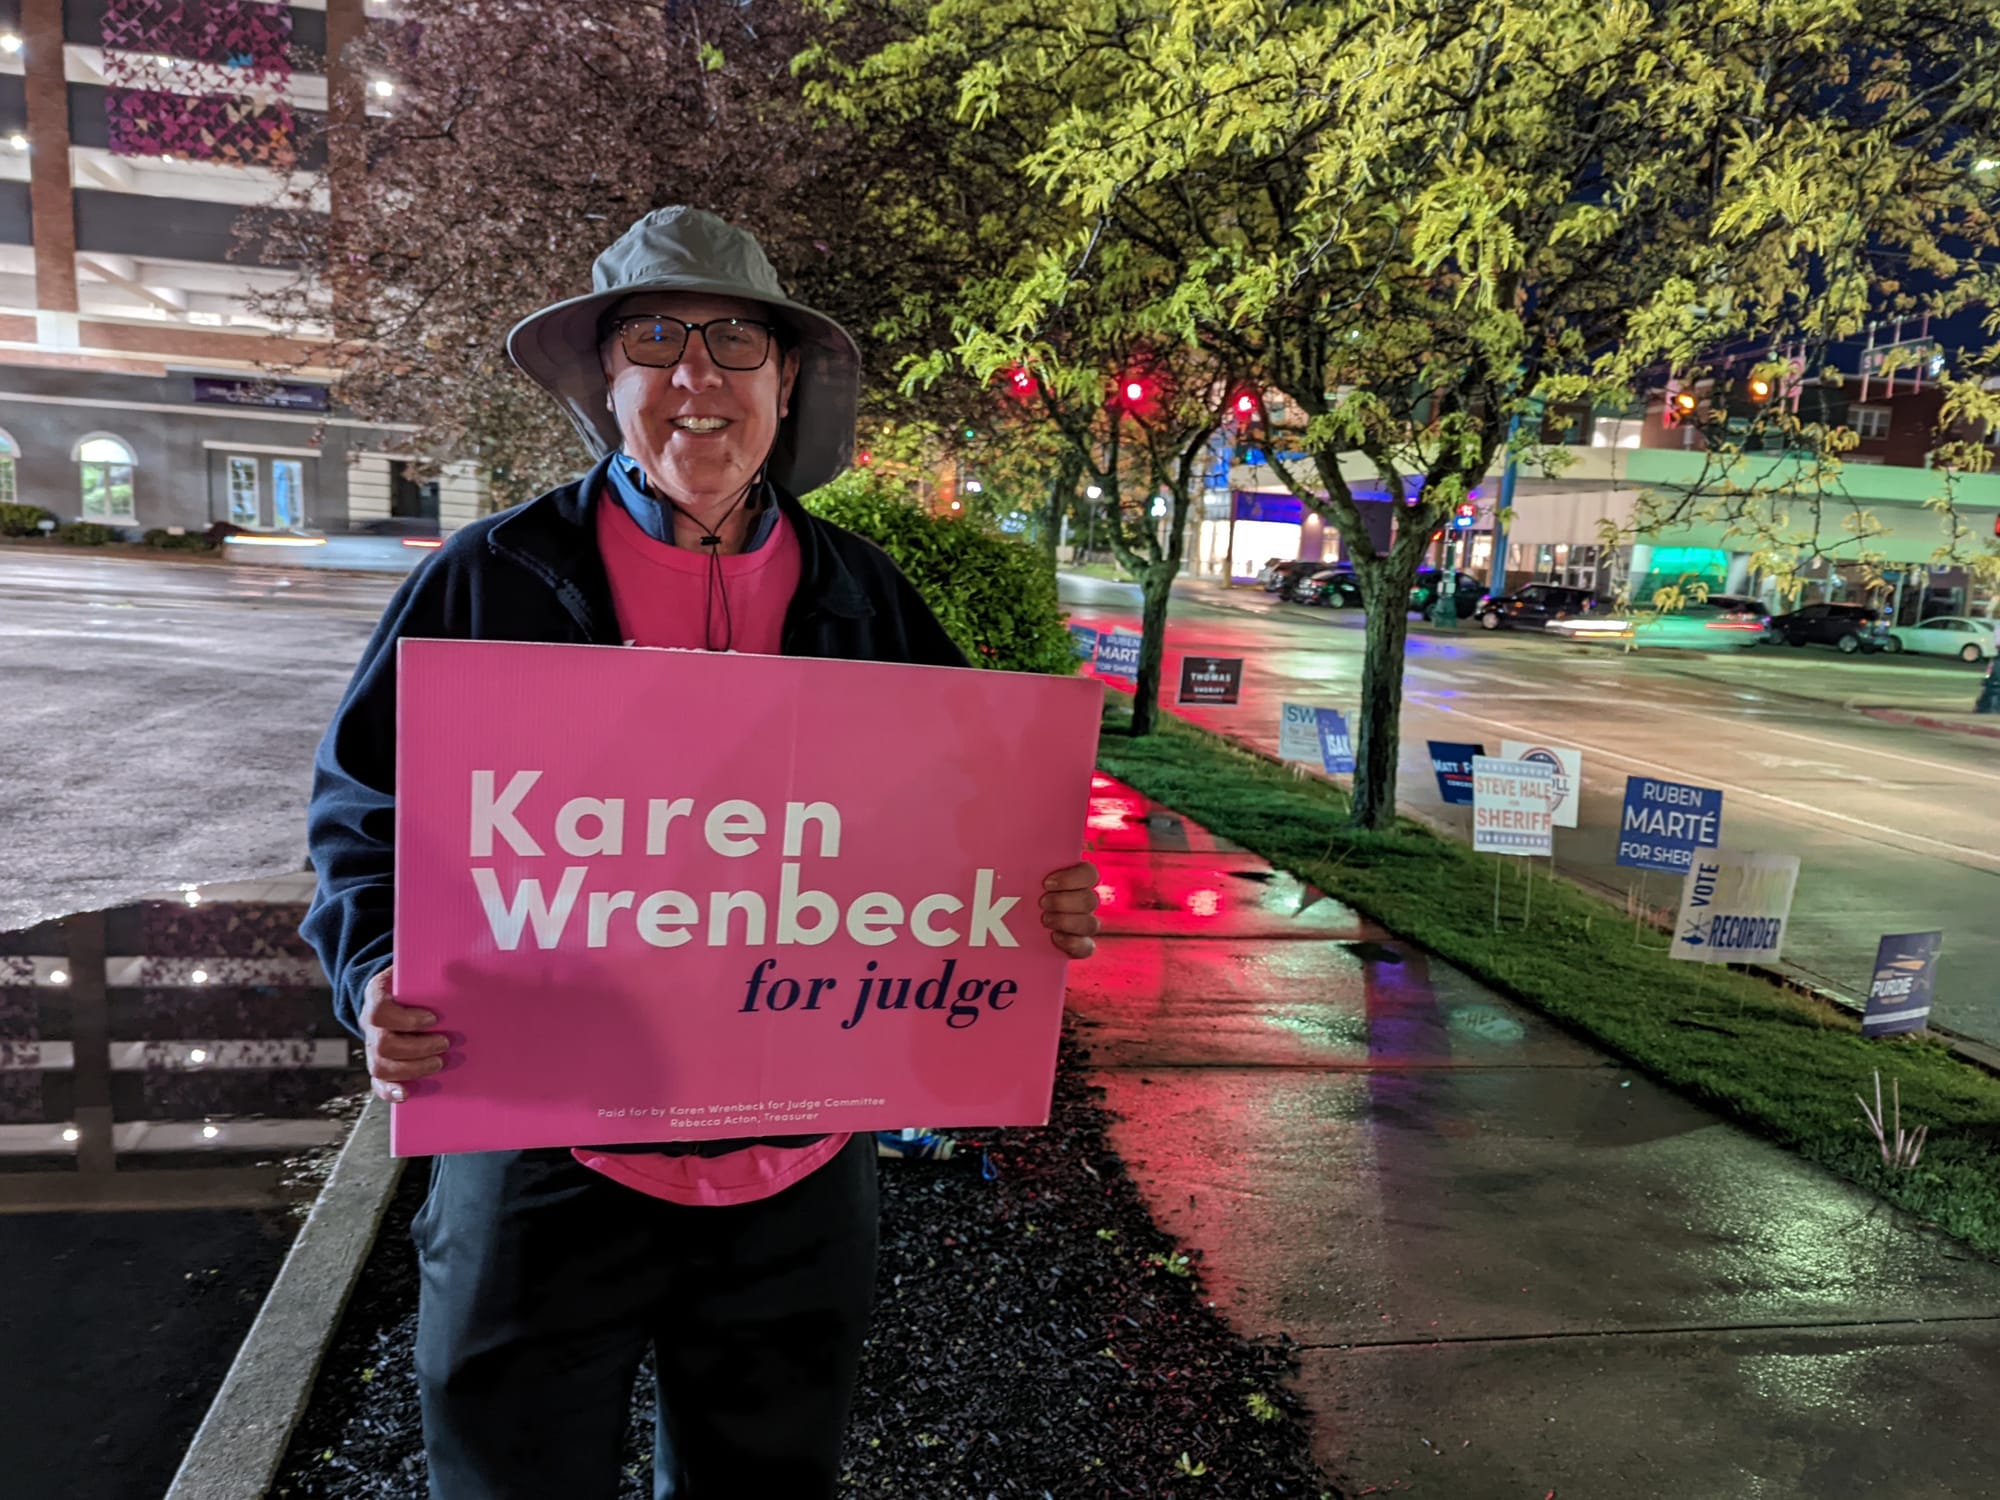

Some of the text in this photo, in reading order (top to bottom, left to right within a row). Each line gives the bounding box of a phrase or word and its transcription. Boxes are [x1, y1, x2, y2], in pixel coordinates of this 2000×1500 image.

[1191, 671, 1231, 682] THOMAS
[1432, 758, 1459, 773] MATT
[1476, 776, 1552, 800] STEVE HALE
[1642, 781, 1703, 808] RUBEN
[470, 770, 842, 859] Karen
[1477, 807, 1552, 832] SHERIFF
[1624, 804, 1717, 843] MARTÉ
[1620, 841, 1651, 860] FOR
[1690, 863, 1720, 907] VOTE
[471, 862, 1021, 951] Wrenbeck
[1707, 914, 1781, 949] RECORDER
[738, 958, 1018, 1030] for judge
[1870, 976, 1914, 998] PURDIE
[597, 1097, 886, 1118] Paid for by Karen Wrenbeck for Judge Committee
[670, 1112, 820, 1128] Rebecca Acton, Treasurer
